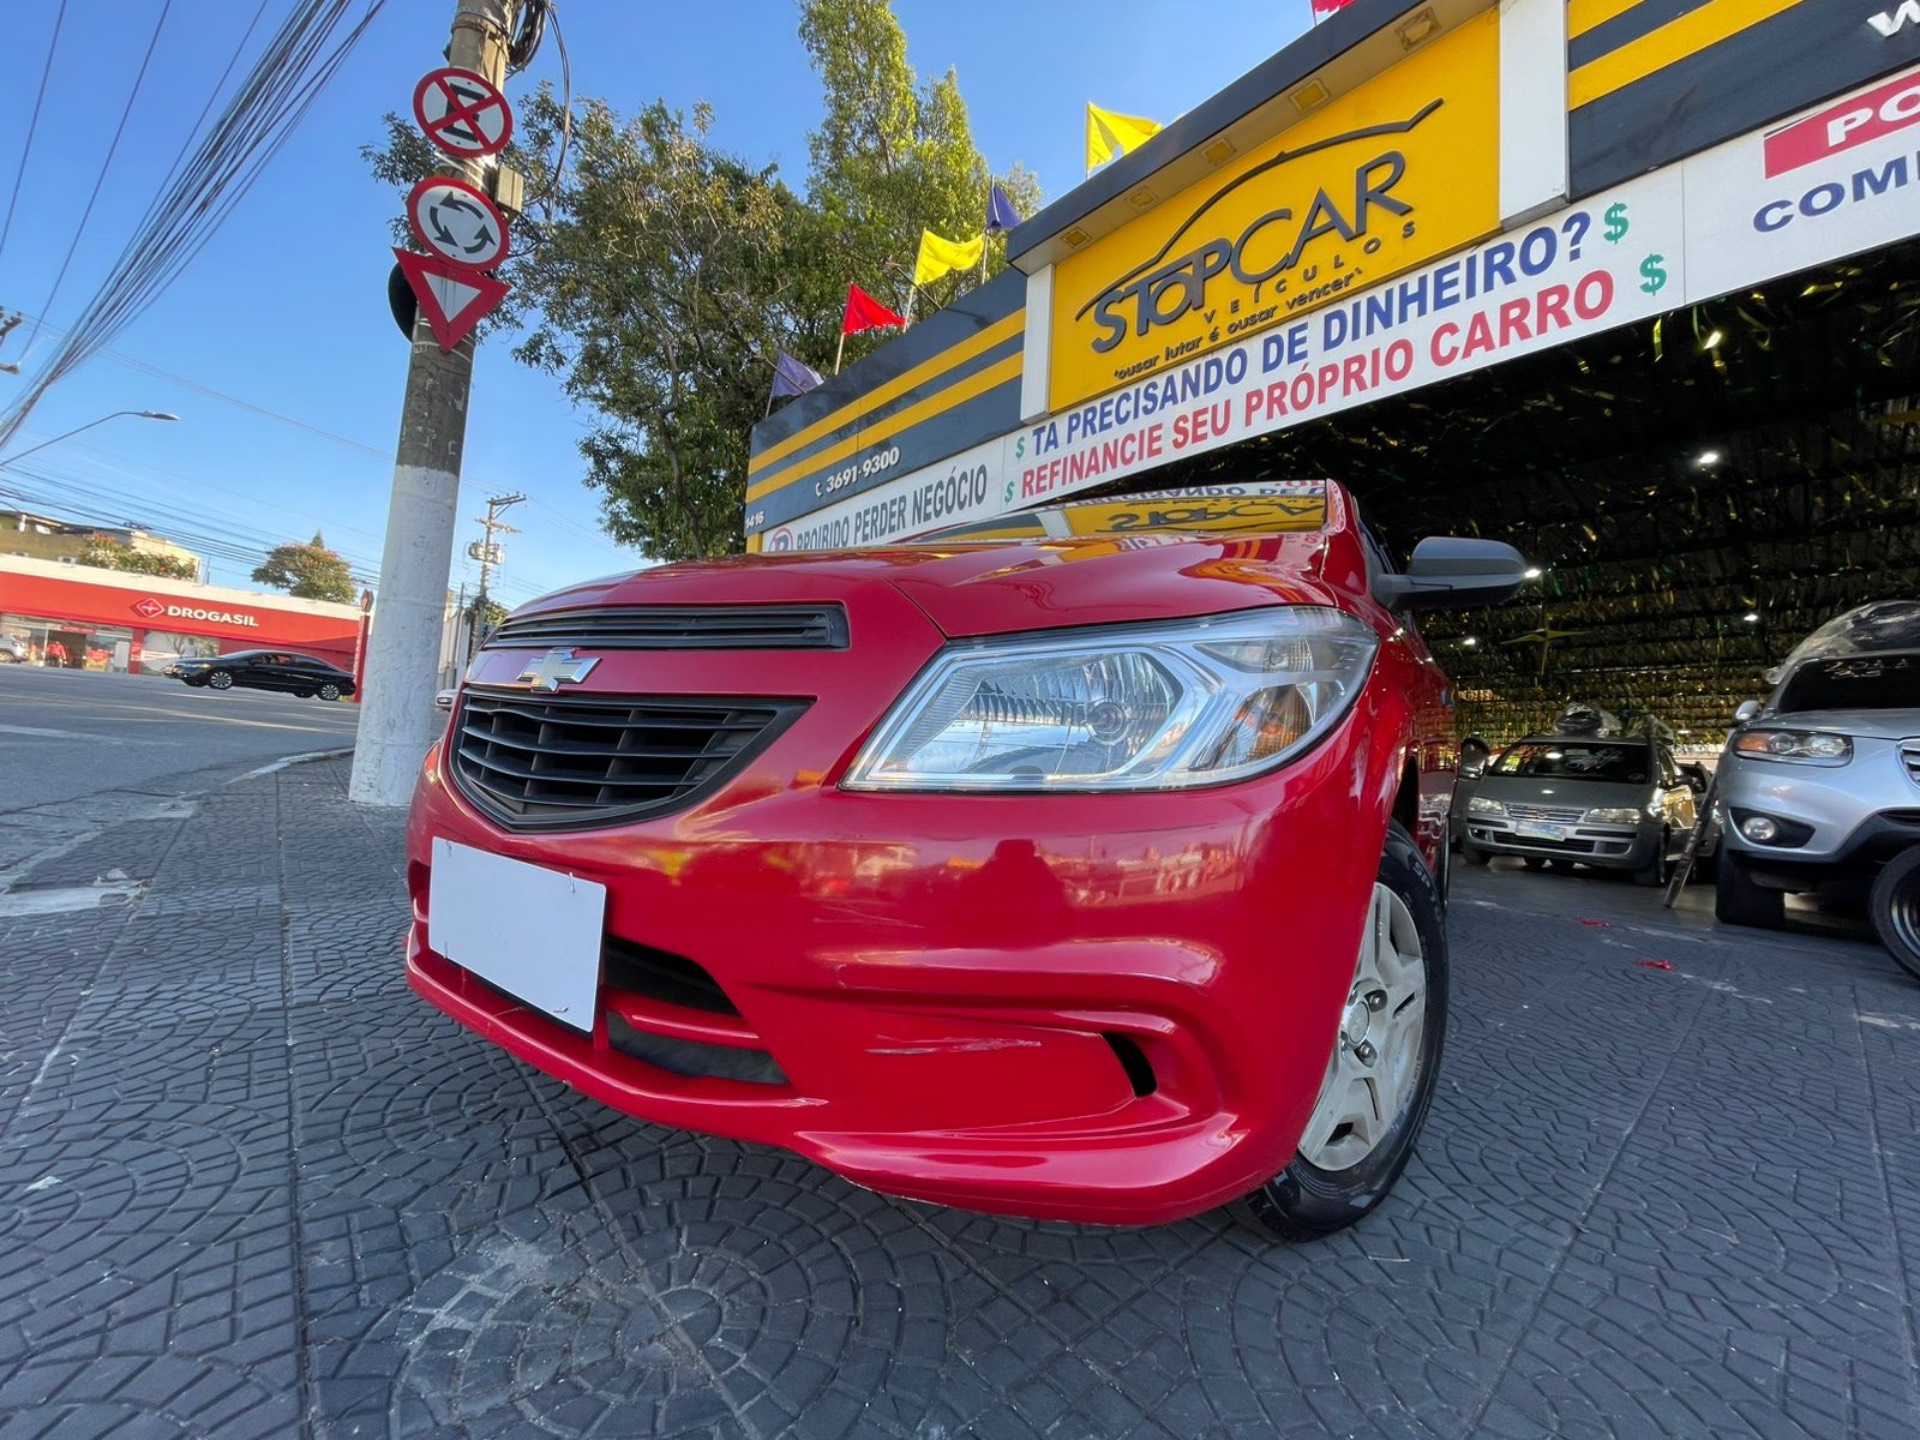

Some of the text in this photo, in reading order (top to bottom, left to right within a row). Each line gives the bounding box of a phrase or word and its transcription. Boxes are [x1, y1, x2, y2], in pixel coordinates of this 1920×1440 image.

[1752, 150, 1920, 233] COM
[1090, 150, 1415, 354] STOPCAR
[1032, 421, 1059, 457] TA
[1066, 347, 1248, 445] PRECISANDO
[1261, 322, 1309, 374] DE
[1322, 211, 1591, 352] DINHEIRO?
[1164, 334, 1204, 362] lutar
[1208, 326, 1220, 342] é
[1226, 304, 1279, 334] ousar
[1021, 422, 1164, 499] REFINANCIE
[1171, 398, 1232, 450] SEU
[1244, 338, 1415, 428] PRÓPRIO
[1430, 269, 1615, 368] CARRO
[853, 494, 907, 545] PERDER
[911, 464, 988, 527] NEGÓCIO
[167, 605, 259, 627] DROGASIL
